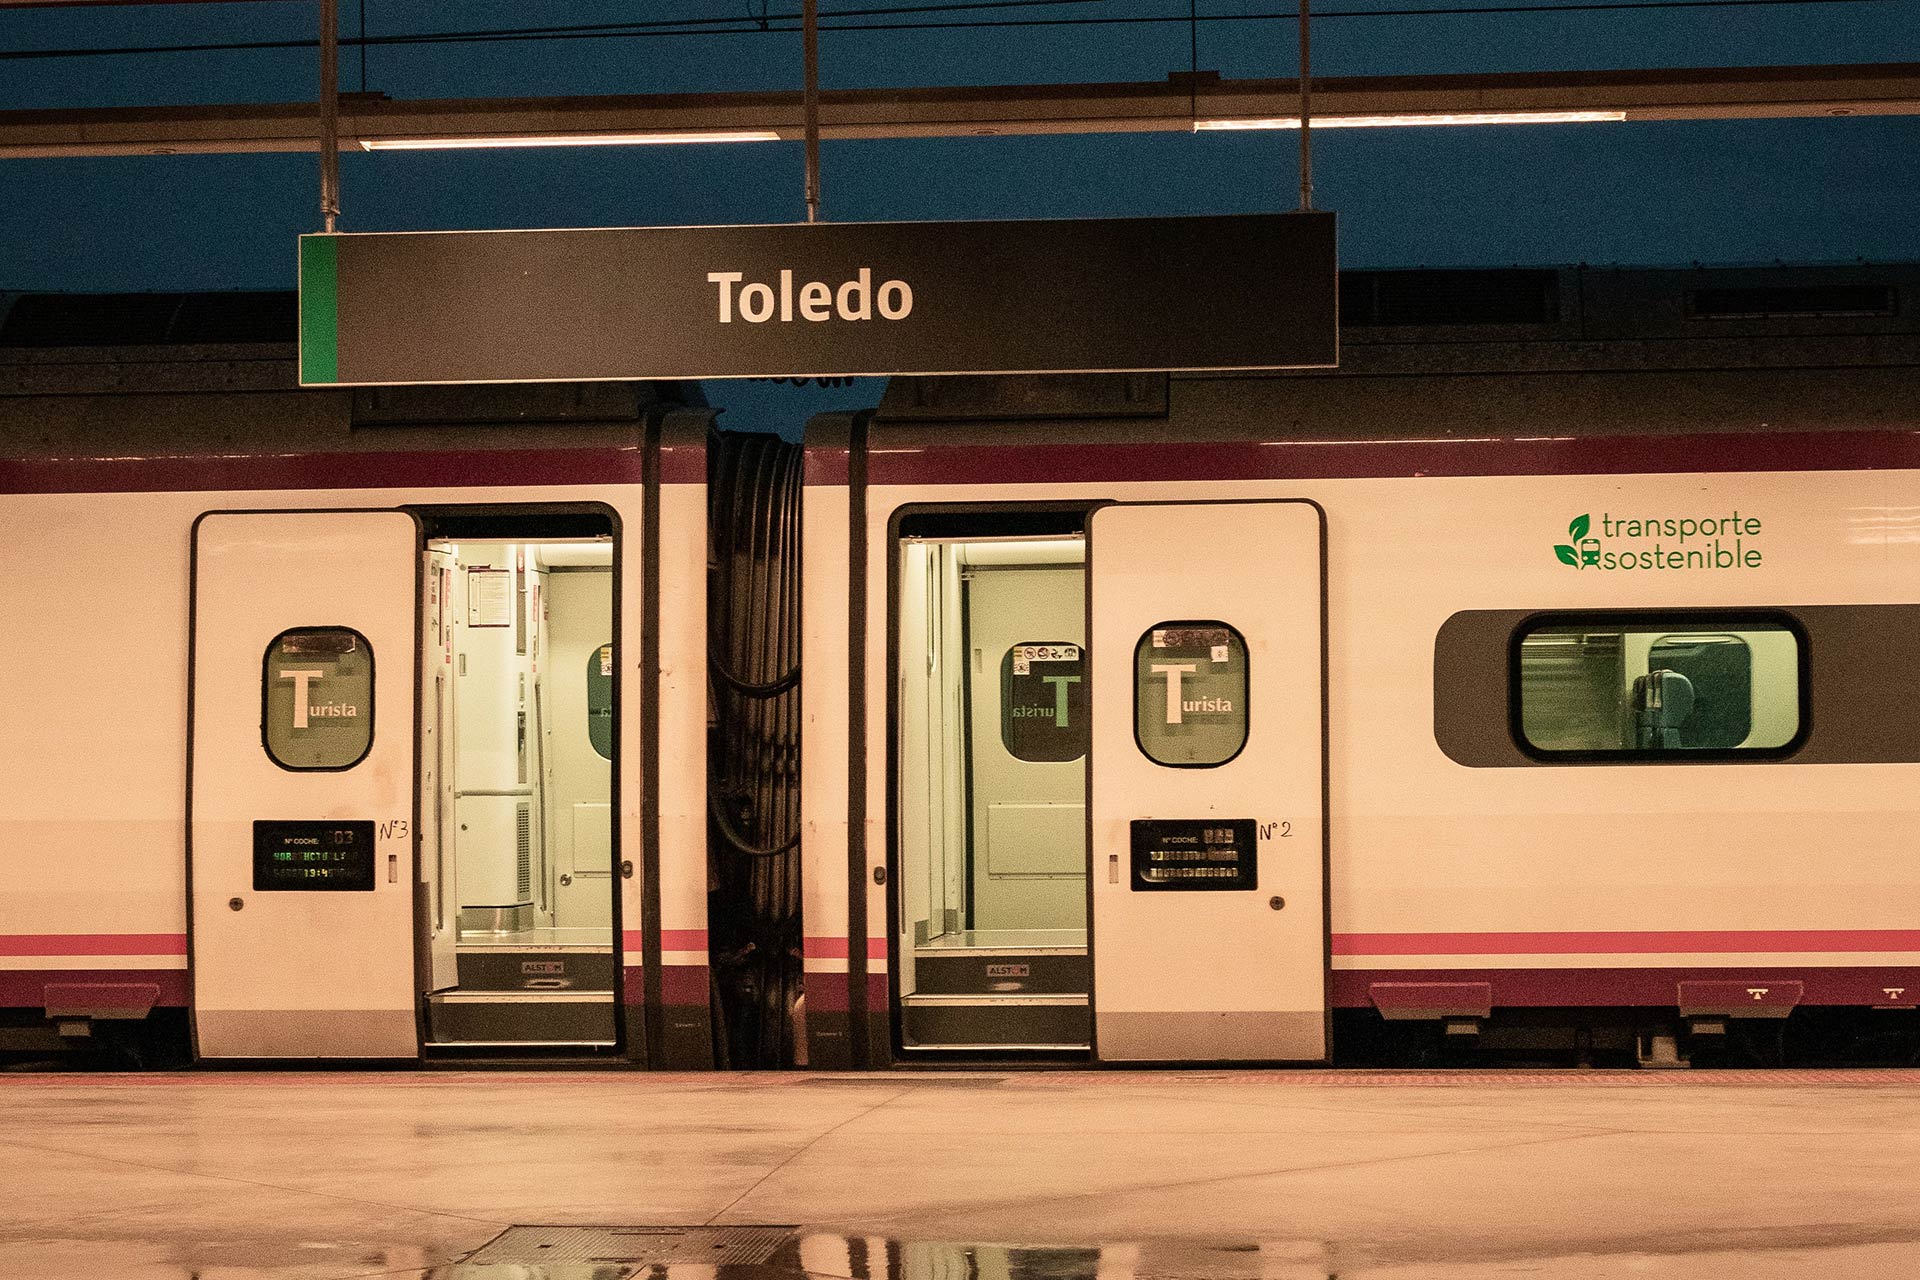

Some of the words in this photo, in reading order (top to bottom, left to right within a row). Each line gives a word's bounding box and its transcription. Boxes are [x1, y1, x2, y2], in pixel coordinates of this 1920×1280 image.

[708, 267, 913, 323] Toledo
[1602, 511, 1762, 544] transporte
[1603, 539, 1762, 570] sostenible
[280, 670, 357, 728] Turista
[1151, 664, 1232, 724] Turista
[990, 966, 1027, 974] ALSTOM
